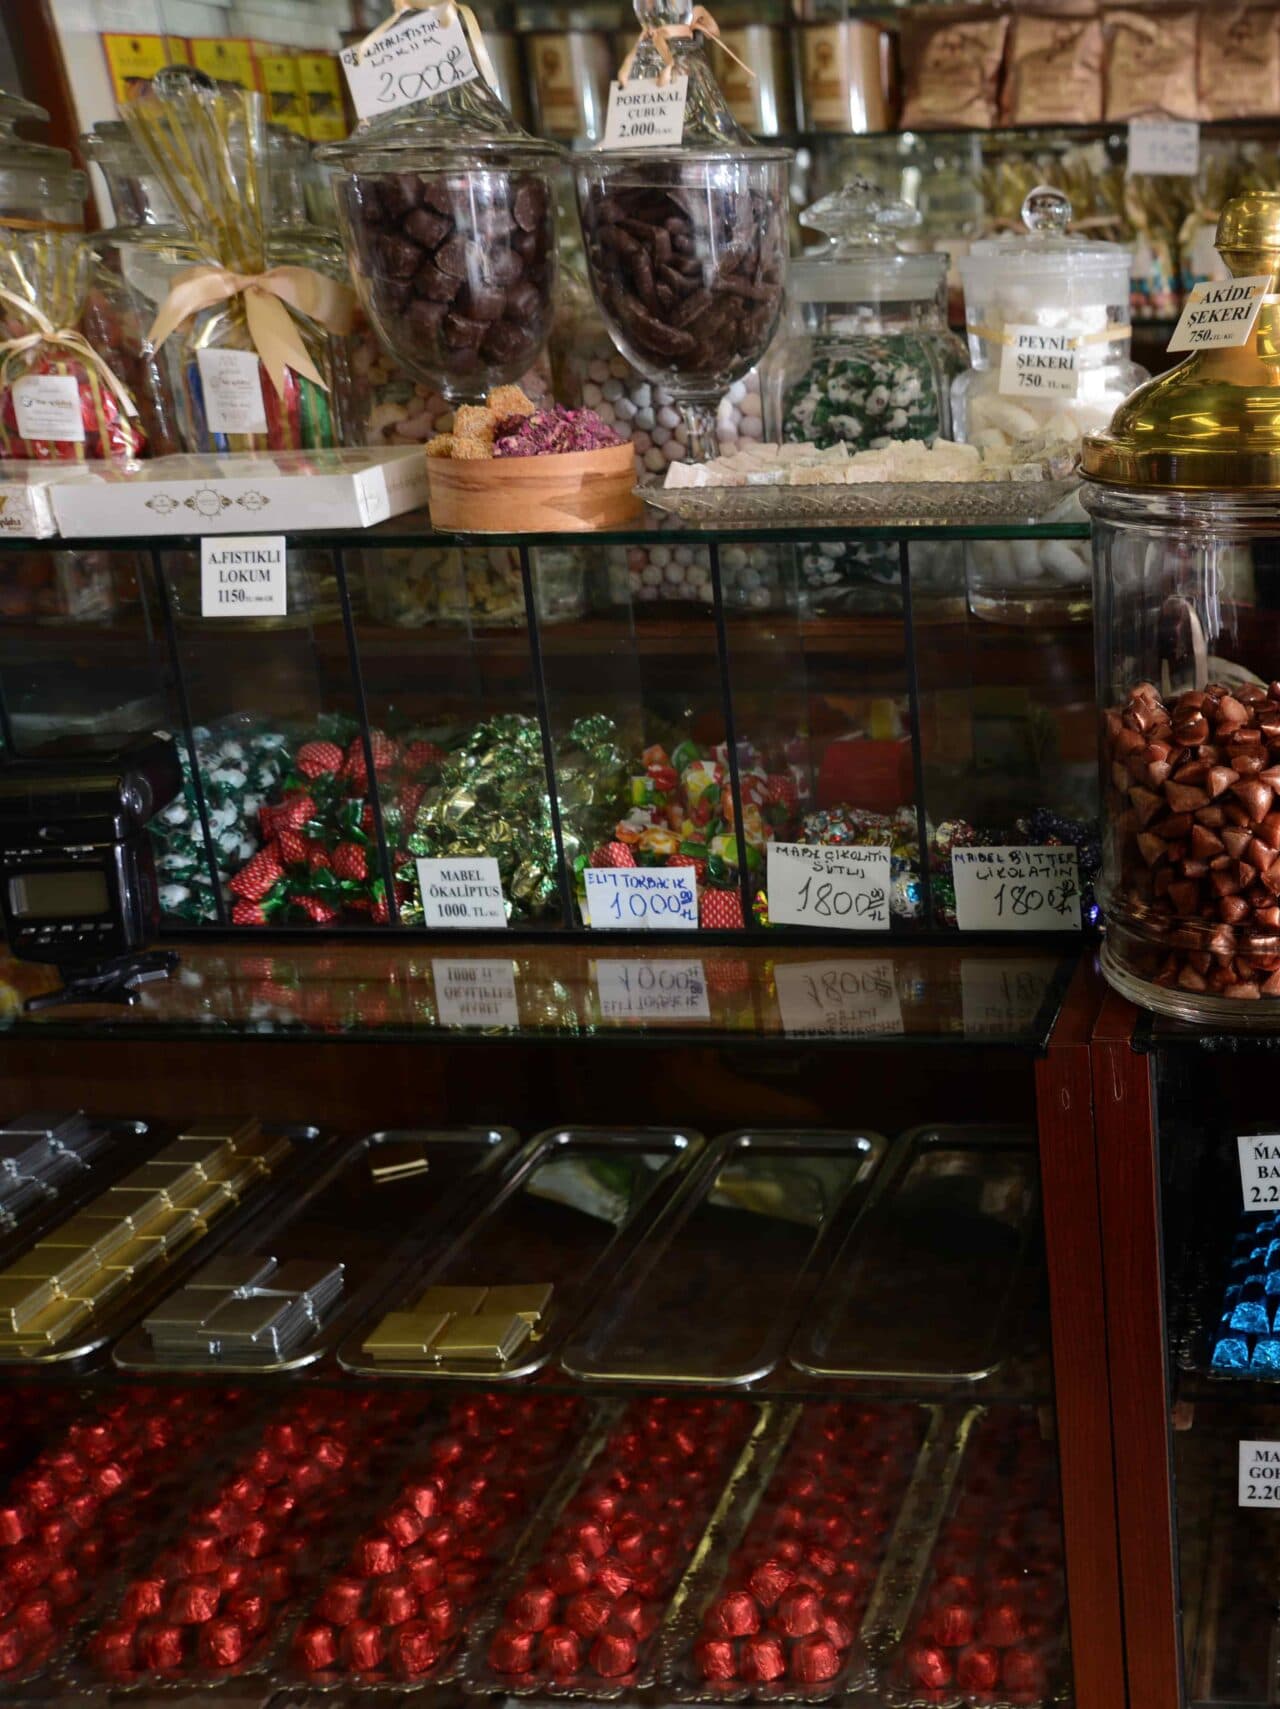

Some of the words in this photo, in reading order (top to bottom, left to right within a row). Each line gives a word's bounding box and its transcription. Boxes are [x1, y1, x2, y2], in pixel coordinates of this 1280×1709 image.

[616, 91, 682, 106] PORTAKAL
[1187, 302, 1254, 328] ŞEKERİ
[207, 549, 281, 565] A.FISTIKLI
[219, 569, 271, 583] LOKUM
[440, 869, 485, 882] MABEL
[429, 884, 500, 898] ÖKALİPTUS
